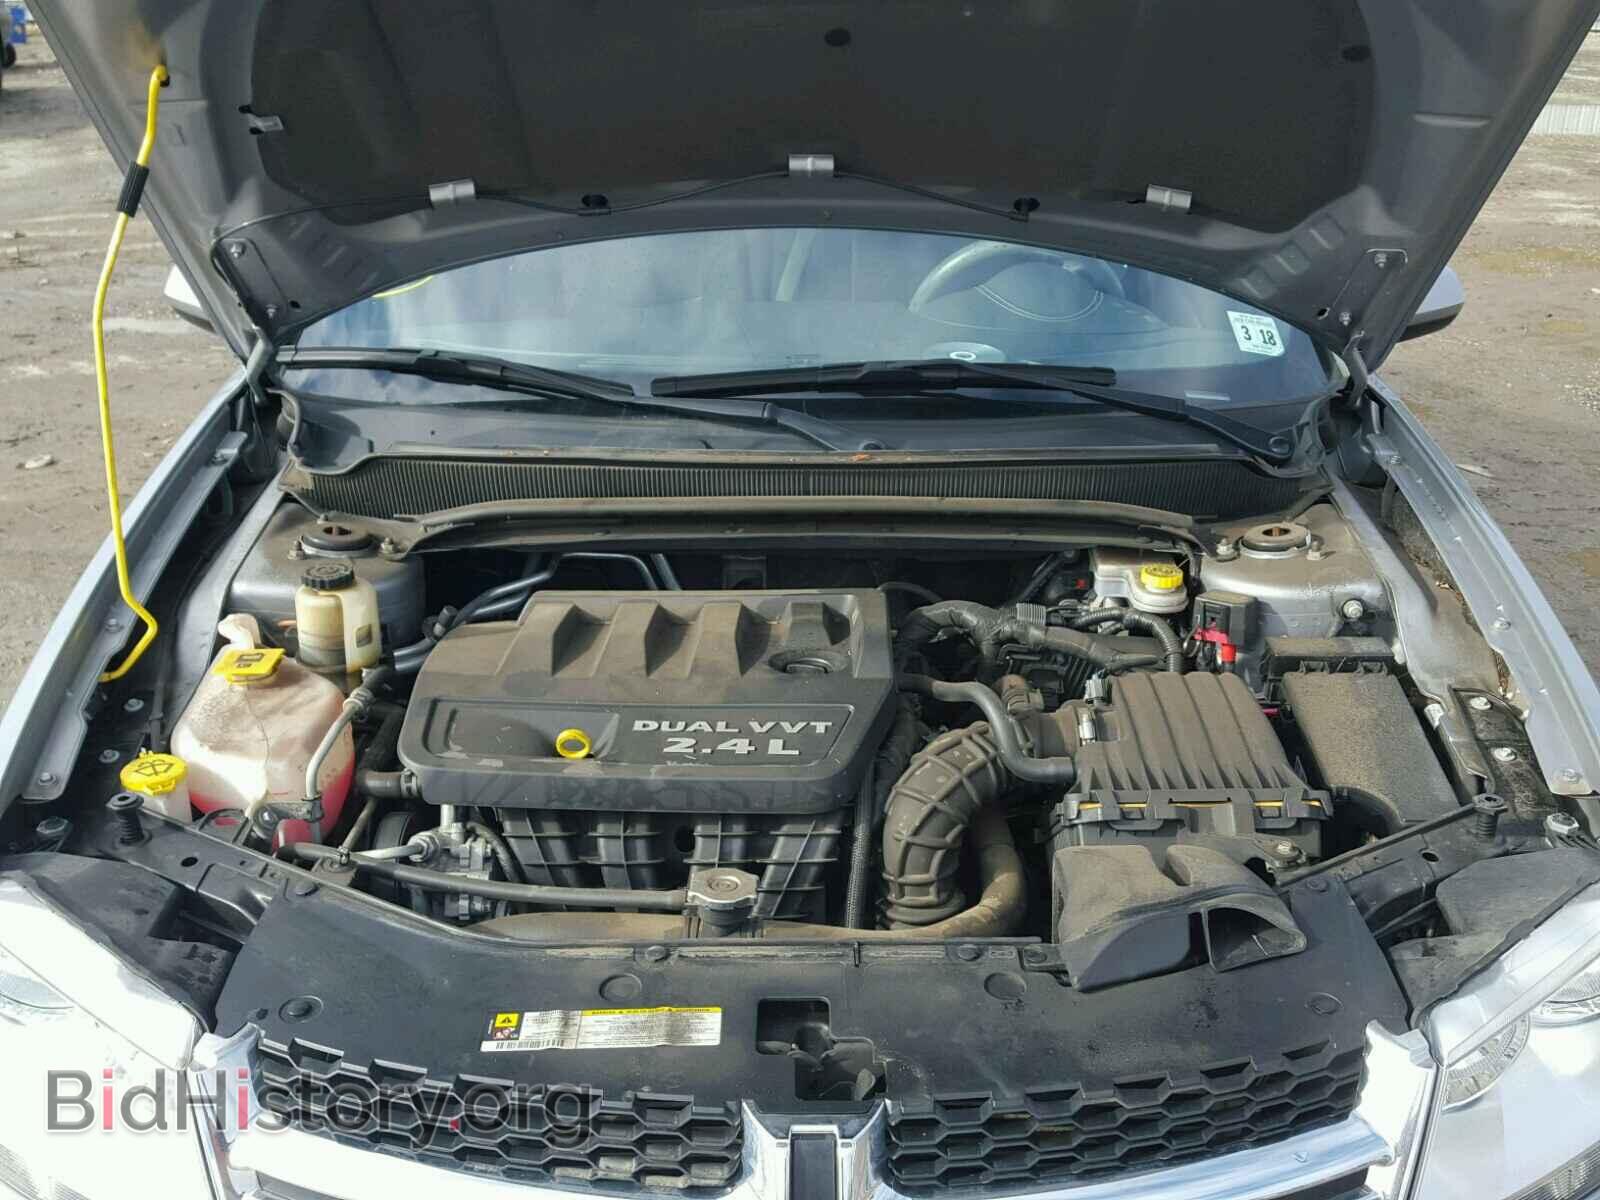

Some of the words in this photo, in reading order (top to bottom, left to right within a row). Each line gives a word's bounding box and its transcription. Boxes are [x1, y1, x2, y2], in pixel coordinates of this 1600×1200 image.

[1241, 325, 1252, 341] 3
[1260, 329, 1277, 346] 18
[632, 720, 739, 733] DUAL
[749, 721, 832, 734] VVT
